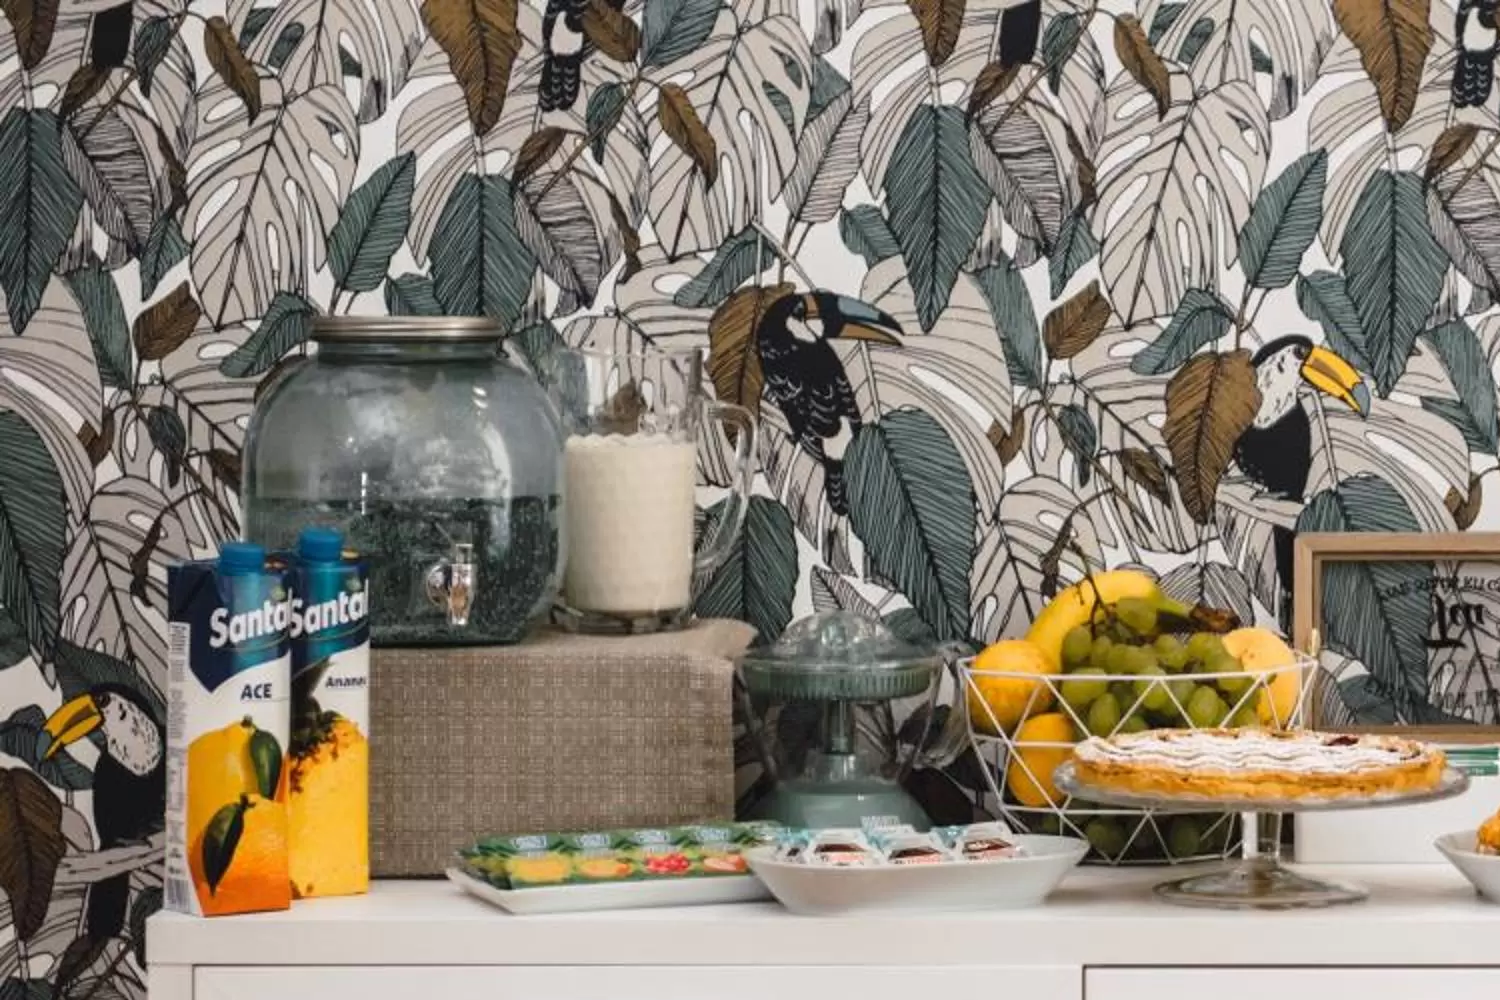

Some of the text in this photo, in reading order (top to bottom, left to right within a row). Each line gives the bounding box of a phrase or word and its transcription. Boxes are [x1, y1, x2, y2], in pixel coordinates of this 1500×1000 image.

[290, 579, 369, 638] Santal
[325, 676, 367, 689] Anana
[240, 683, 273, 700] ACE
